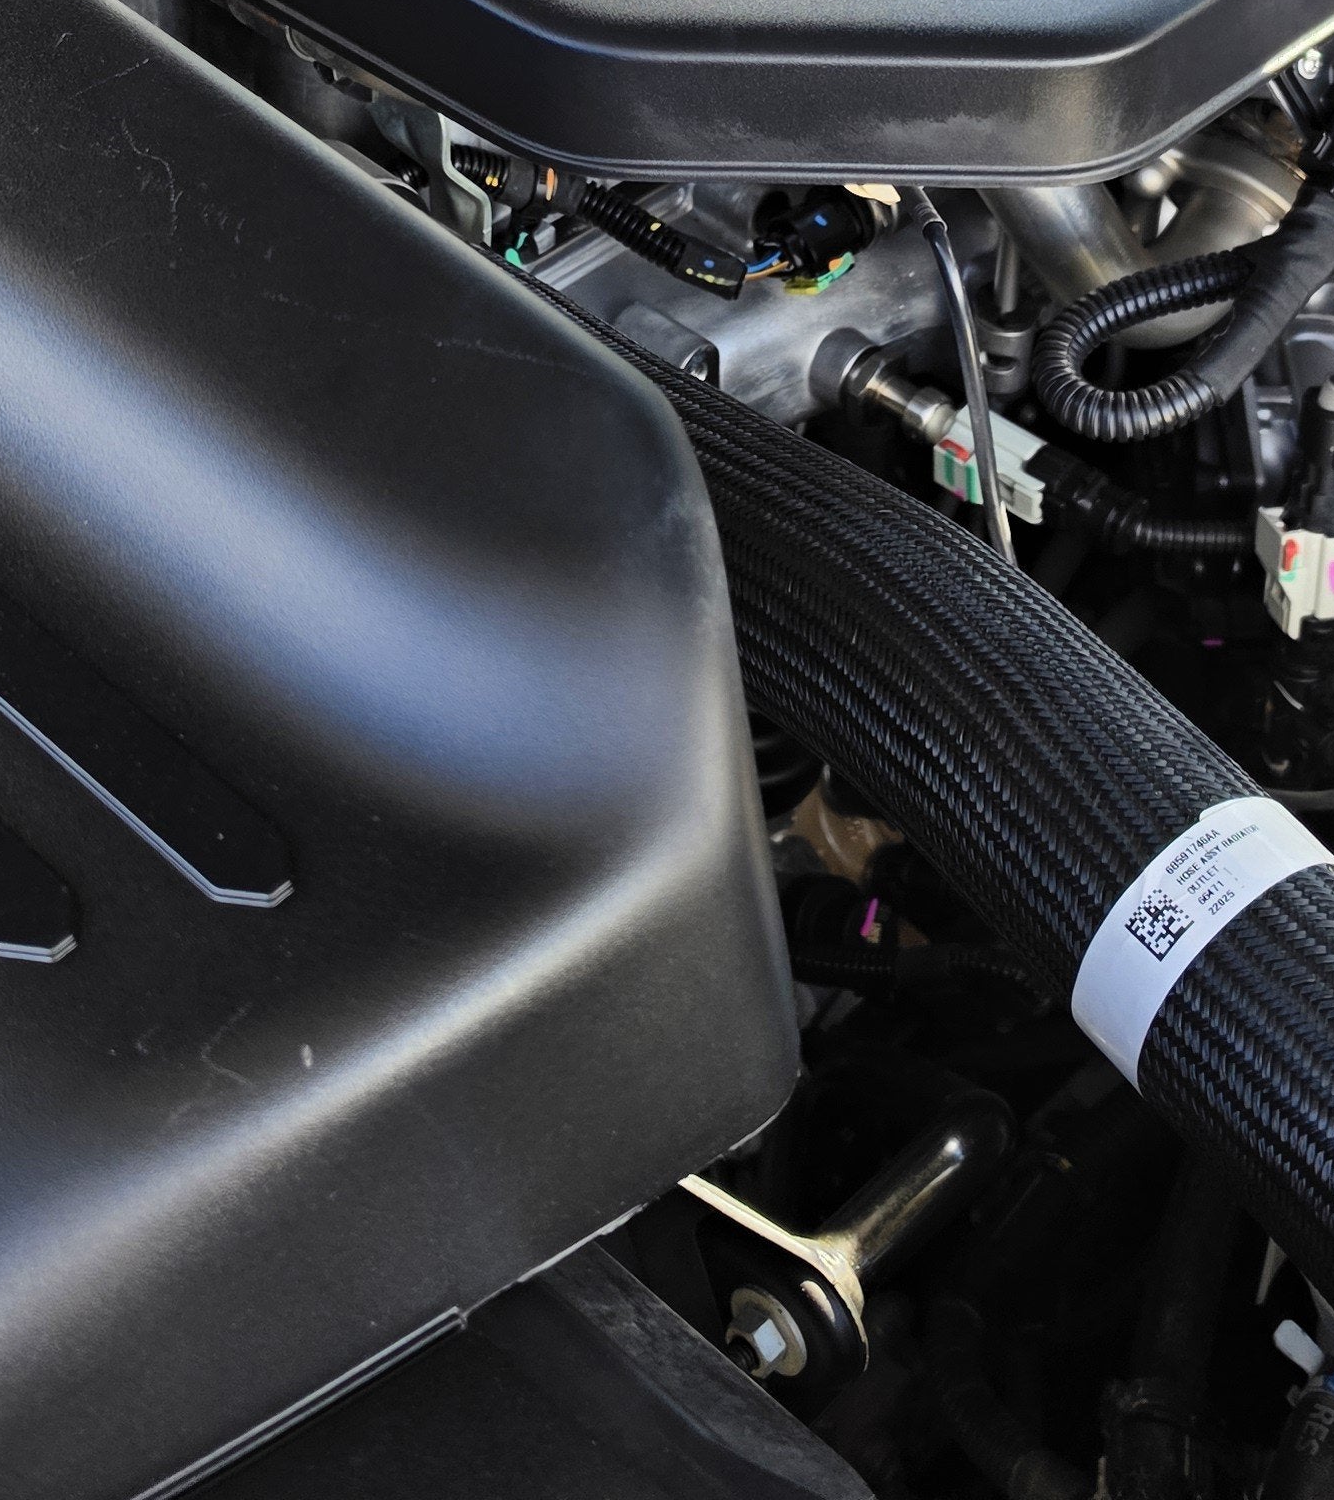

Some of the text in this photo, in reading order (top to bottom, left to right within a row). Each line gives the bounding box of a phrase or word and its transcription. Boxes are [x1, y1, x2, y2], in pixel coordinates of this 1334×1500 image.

[1176, 824, 1260, 886] HOSE ASSY RADIATOR
[1187, 865, 1220, 895] OUTLET
[1207, 889, 1236, 916] 22025
